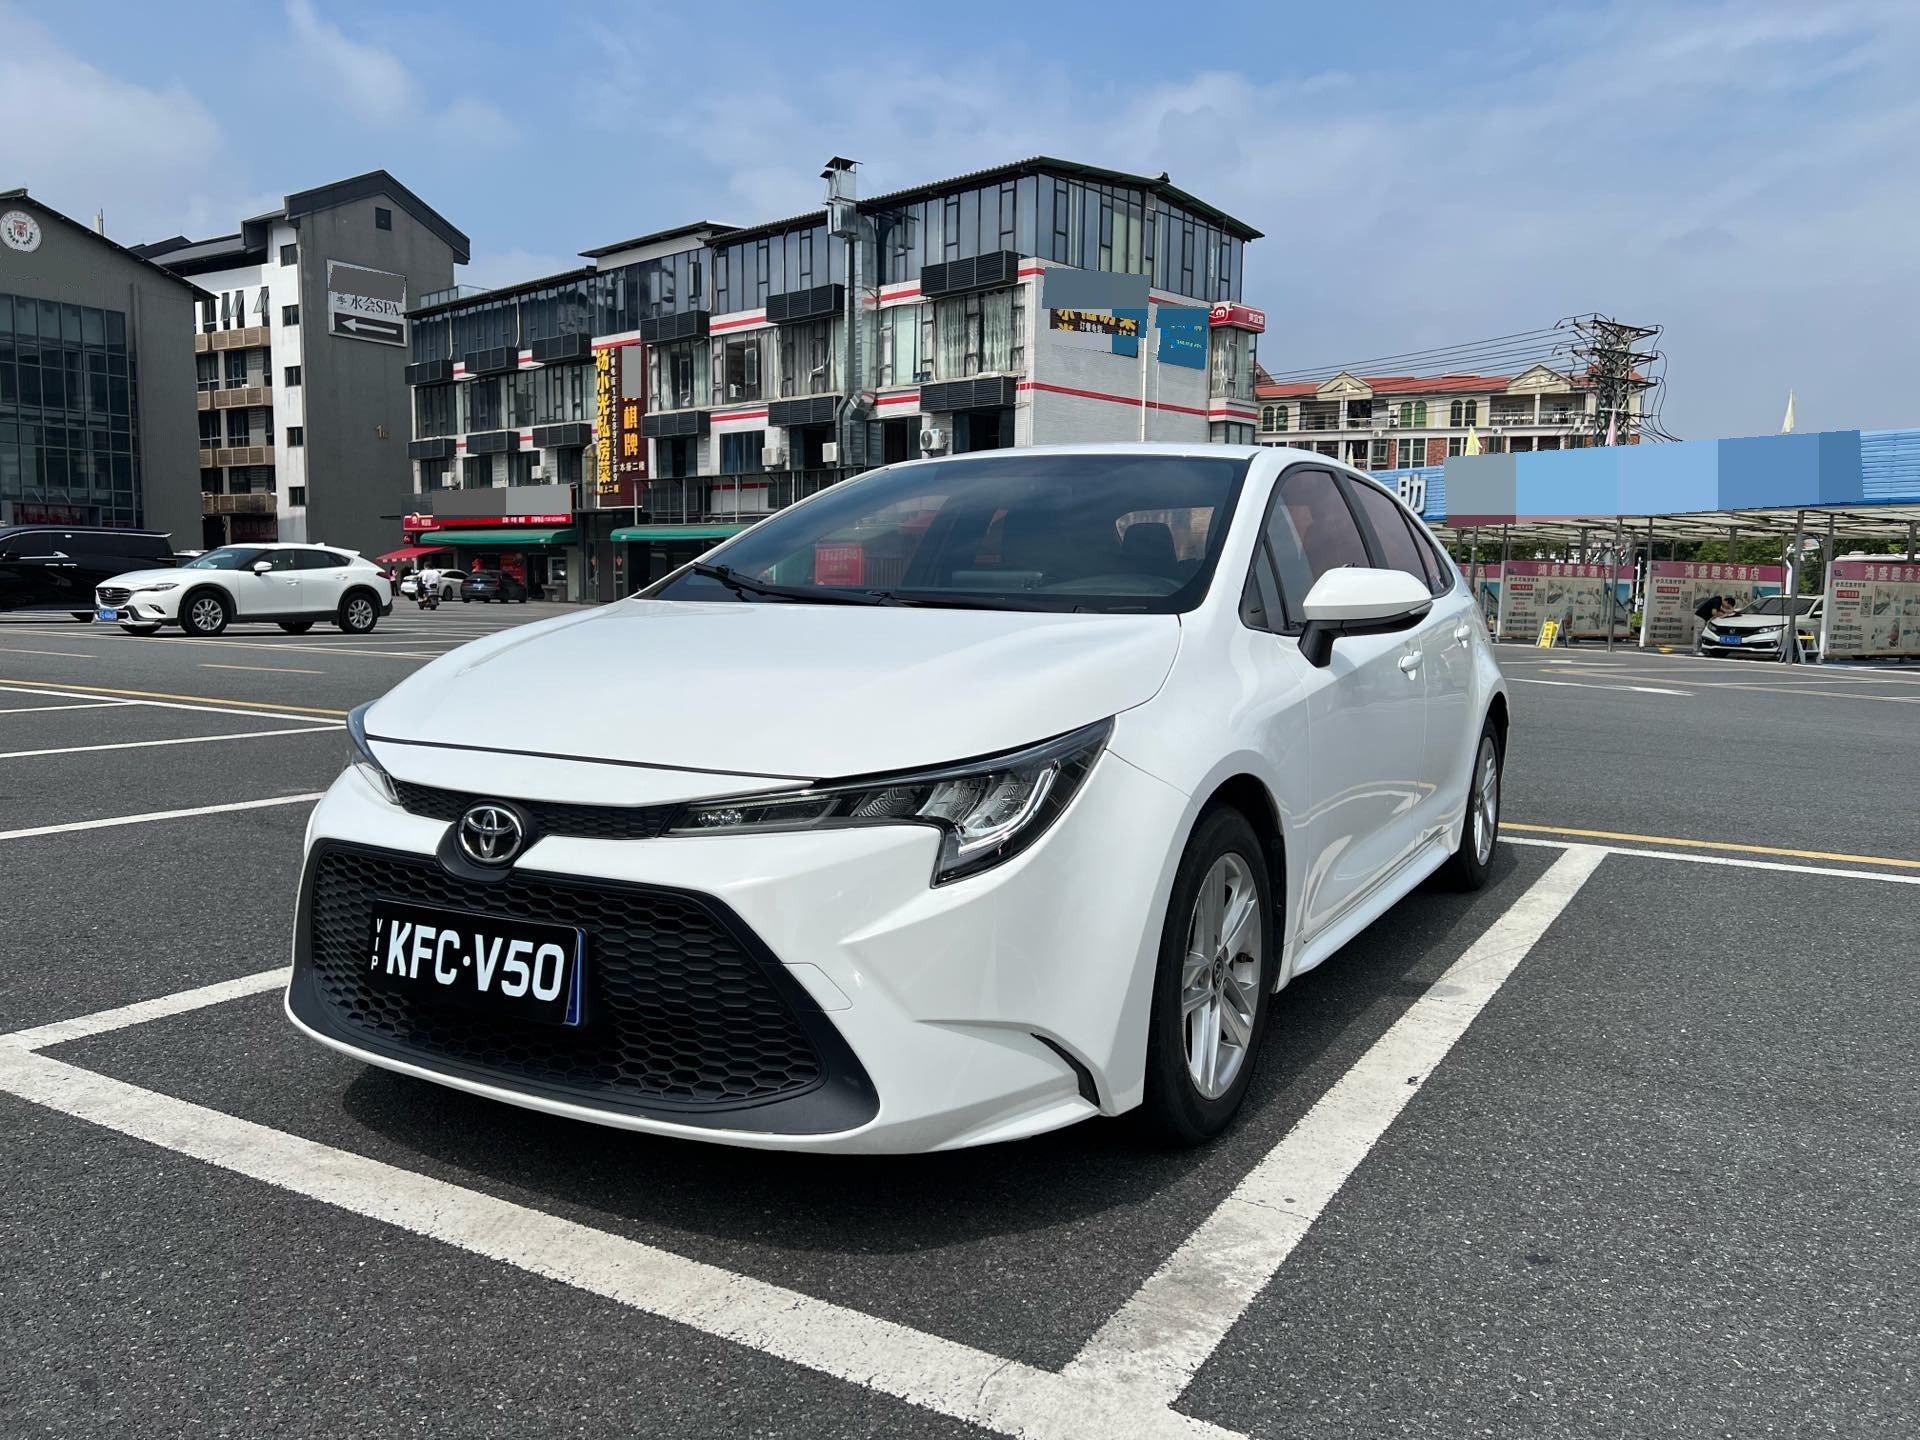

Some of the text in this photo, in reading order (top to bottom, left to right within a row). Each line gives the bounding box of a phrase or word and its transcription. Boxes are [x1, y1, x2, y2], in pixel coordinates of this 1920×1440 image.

[596, 348, 611, 483] 杨小光私房菜
[624, 397, 639, 457] 棋牌
[370, 917, 383, 971] VIP
